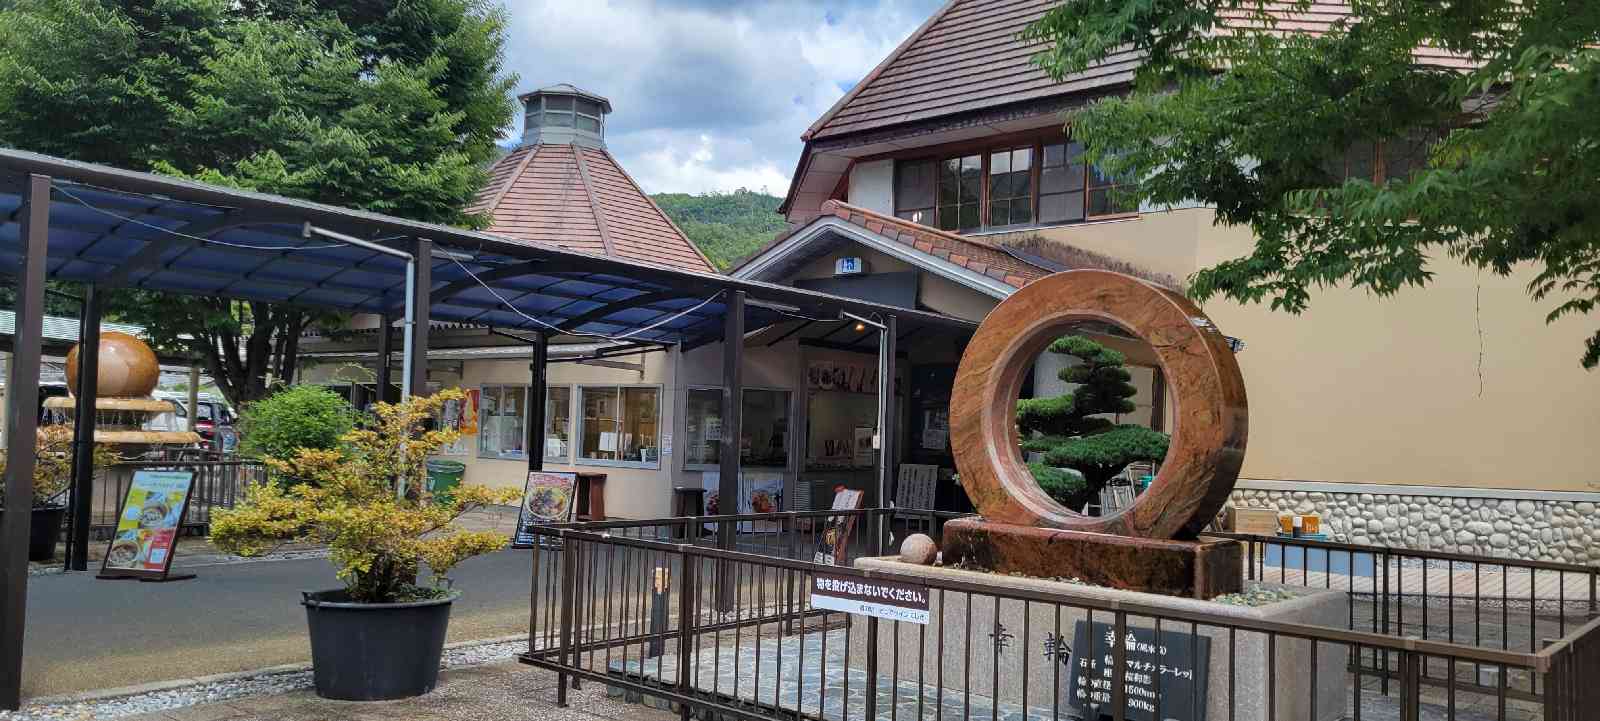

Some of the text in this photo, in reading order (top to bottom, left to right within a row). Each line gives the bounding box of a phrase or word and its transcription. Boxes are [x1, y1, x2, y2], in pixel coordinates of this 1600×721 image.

[816, 577, 926, 604] 物を投げ込まないでください。
[1043, 631, 1073, 666] 輪
